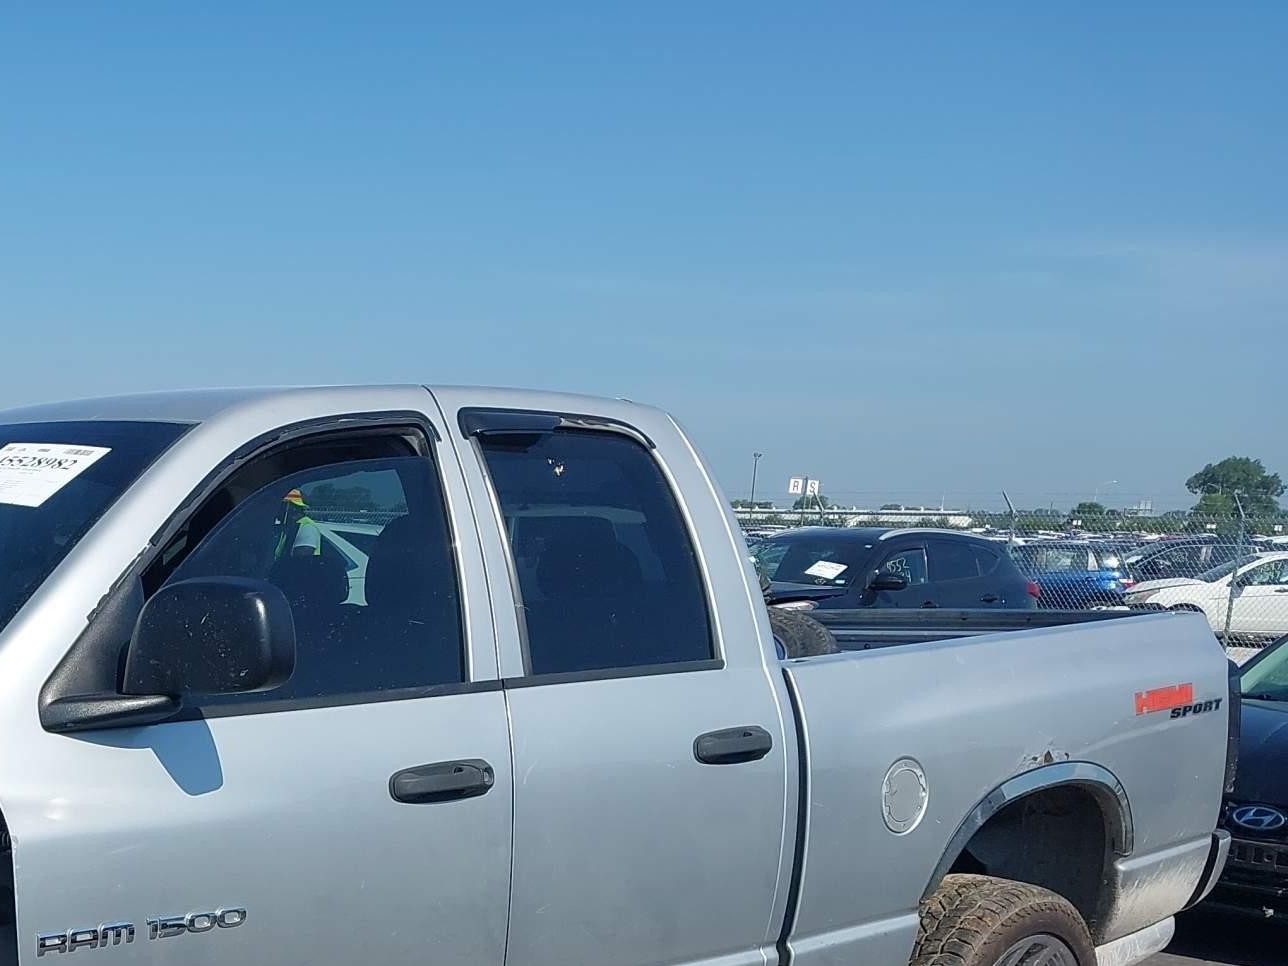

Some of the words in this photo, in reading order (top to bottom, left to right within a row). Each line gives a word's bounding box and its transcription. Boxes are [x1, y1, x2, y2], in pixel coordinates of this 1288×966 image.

[792, 480, 800, 491] R
[1169, 698, 1223, 720] SPORT
[36, 920, 136, 957] RAM
[145, 906, 247, 941] 1500
